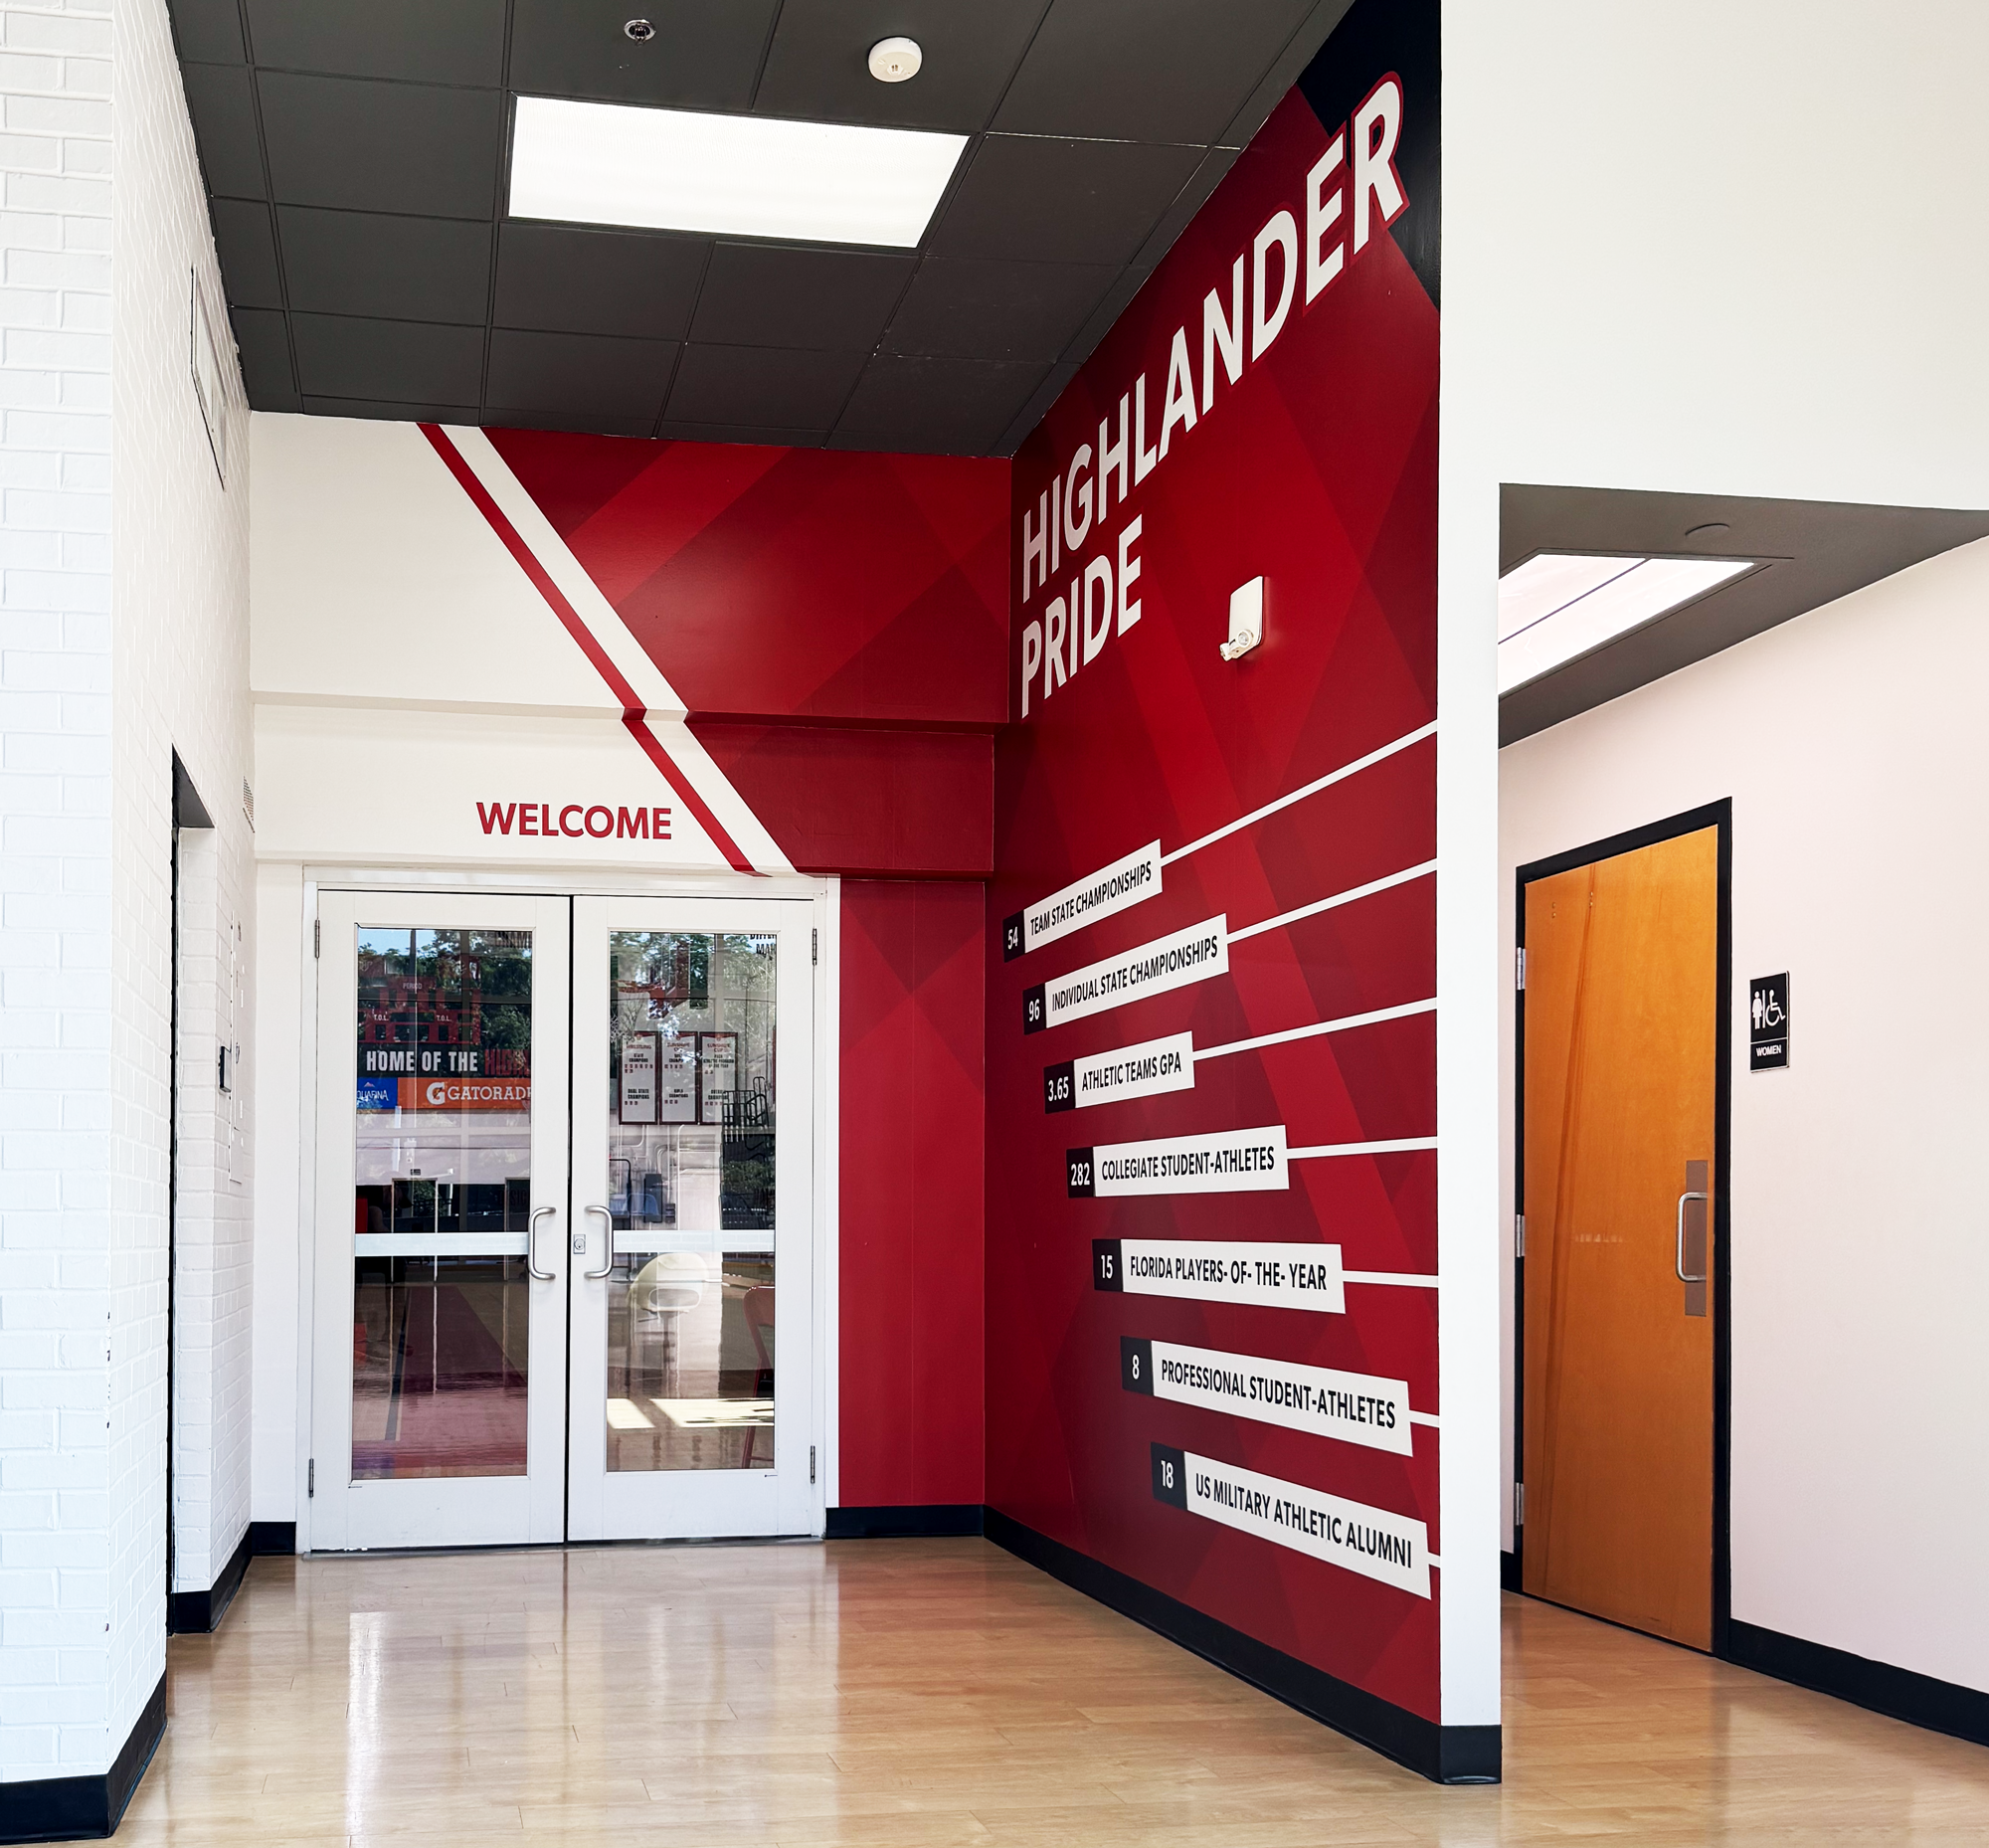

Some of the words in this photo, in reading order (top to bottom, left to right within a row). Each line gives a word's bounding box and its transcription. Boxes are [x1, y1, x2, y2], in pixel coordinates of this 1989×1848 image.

[1022, 81, 1404, 604] HIGHLANDER
[1021, 513, 1143, 719] PRIDE
[475, 801, 672, 840] WELCOME
[1007, 926, 1018, 950] 54
[1030, 911, 1050, 936] TEAM
[1051, 898, 1074, 926] STATE
[1076, 860, 1152, 914] CHAMPIONSHIPS
[1029, 999, 1040, 1021] 96
[1052, 979, 1099, 1012] INDIVIDUAL
[1101, 968, 1128, 996] STATE
[1130, 935, 1218, 985] CHAMPIONSHIPS
[366, 1050, 415, 1071] HOME
[422, 1051, 442, 1071] OF
[449, 1051, 477, 1071] THE
[1048, 1076, 1069, 1101] 3.65
[1082, 1064, 1123, 1091] ATHLETIC
[1125, 1056, 1158, 1082] TEAMS
[1160, 1051, 1181, 1075] GPA
[1755, 1044, 1782, 1057] WOMEN
[1071, 1163, 1090, 1186] 282
[1102, 1157, 1159, 1181] COLLEGIATE
[1161, 1146, 1274, 1177] STUDENT-ATHLETES
[1101, 1255, 1113, 1279] 15
[1131, 1255, 1174, 1279] FLORIDA
[1175, 1258, 1228, 1283] PLAYERS-
[1230, 1260, 1252, 1284] OF-
[1255, 1261, 1286, 1287] THE-
[1289, 1263, 1327, 1290] YEAR
[1132, 1355, 1141, 1380] 8
[1162, 1359, 1247, 1398] PROFESSIONAL
[1249, 1376, 1396, 1429] STUDENT-ATHLETES
[1161, 1460, 1174, 1489] 18
[1195, 1473, 1211, 1499] US
[1213, 1479, 1270, 1520] MILITARY
[1274, 1499, 1342, 1545] ATHLETIC
[1346, 1522, 1412, 1569] ALUMNI
